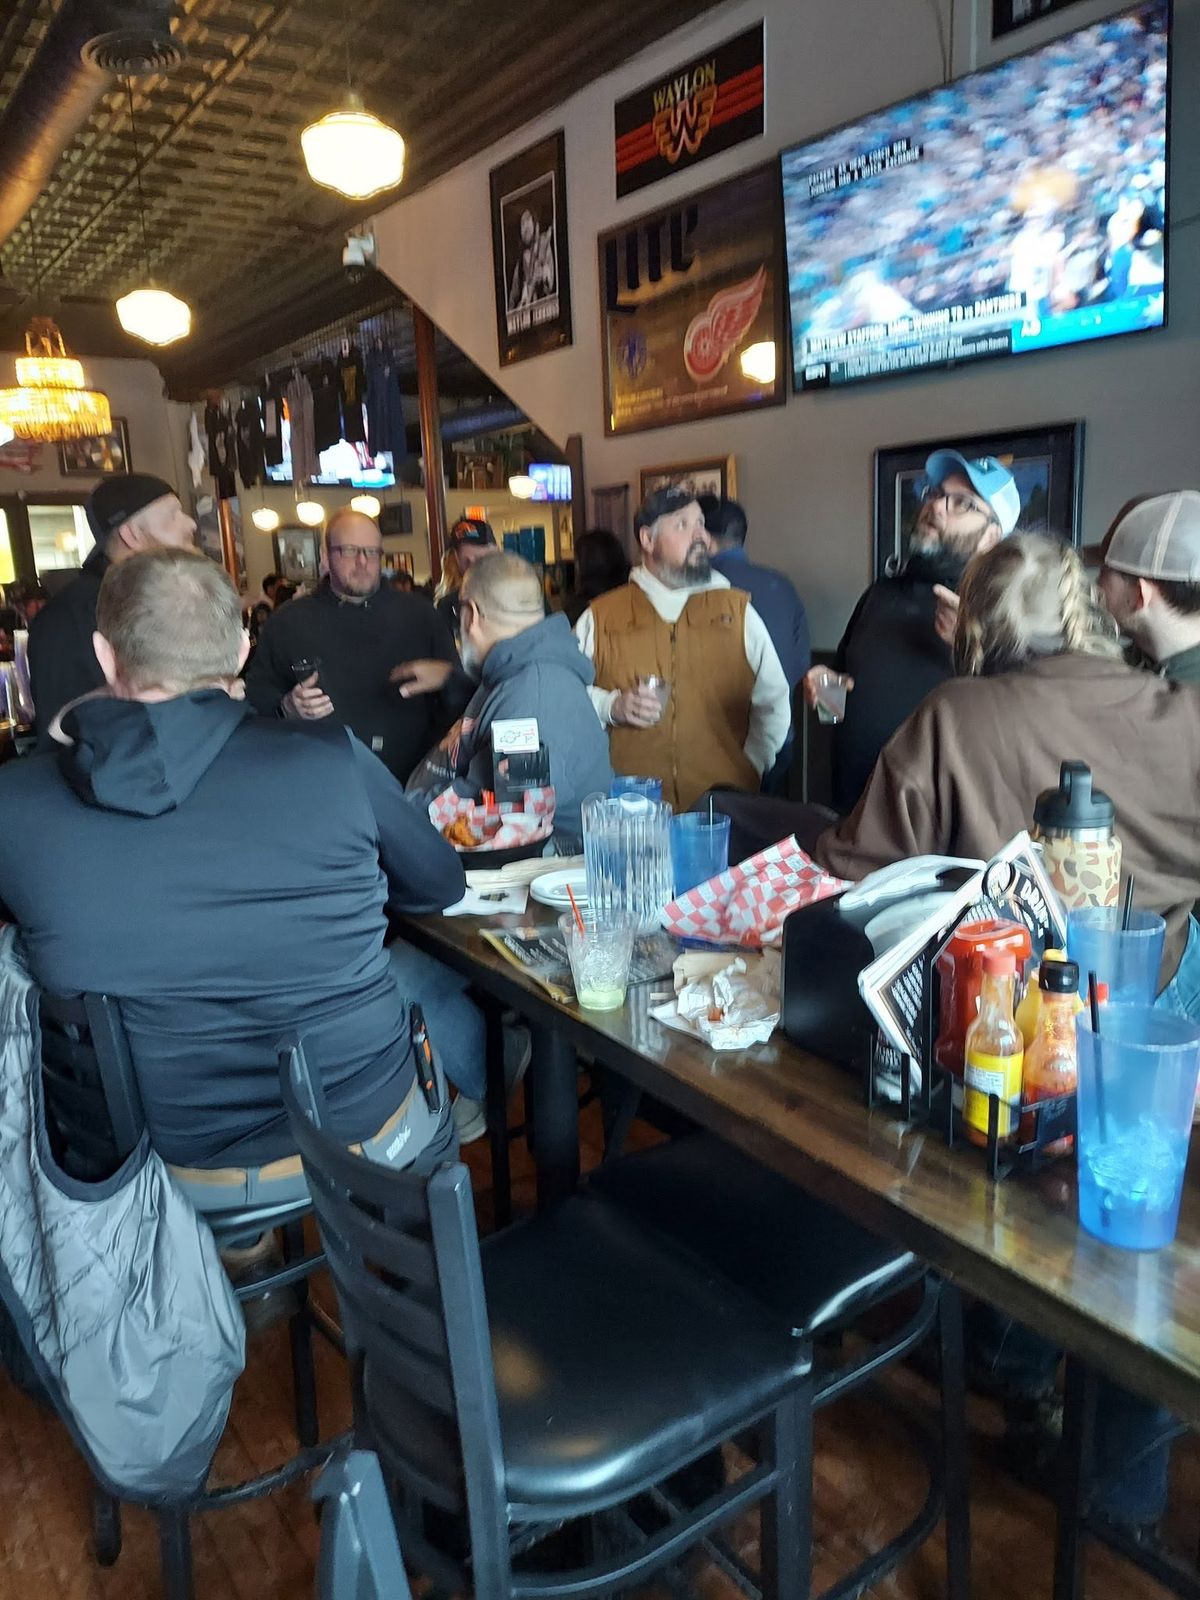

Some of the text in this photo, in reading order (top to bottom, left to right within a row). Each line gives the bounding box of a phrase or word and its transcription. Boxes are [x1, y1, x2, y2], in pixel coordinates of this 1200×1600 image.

[653, 58, 716, 112] WAYLON
[952, 305, 963, 323] TD
[974, 292, 1022, 318] PANTHERS
